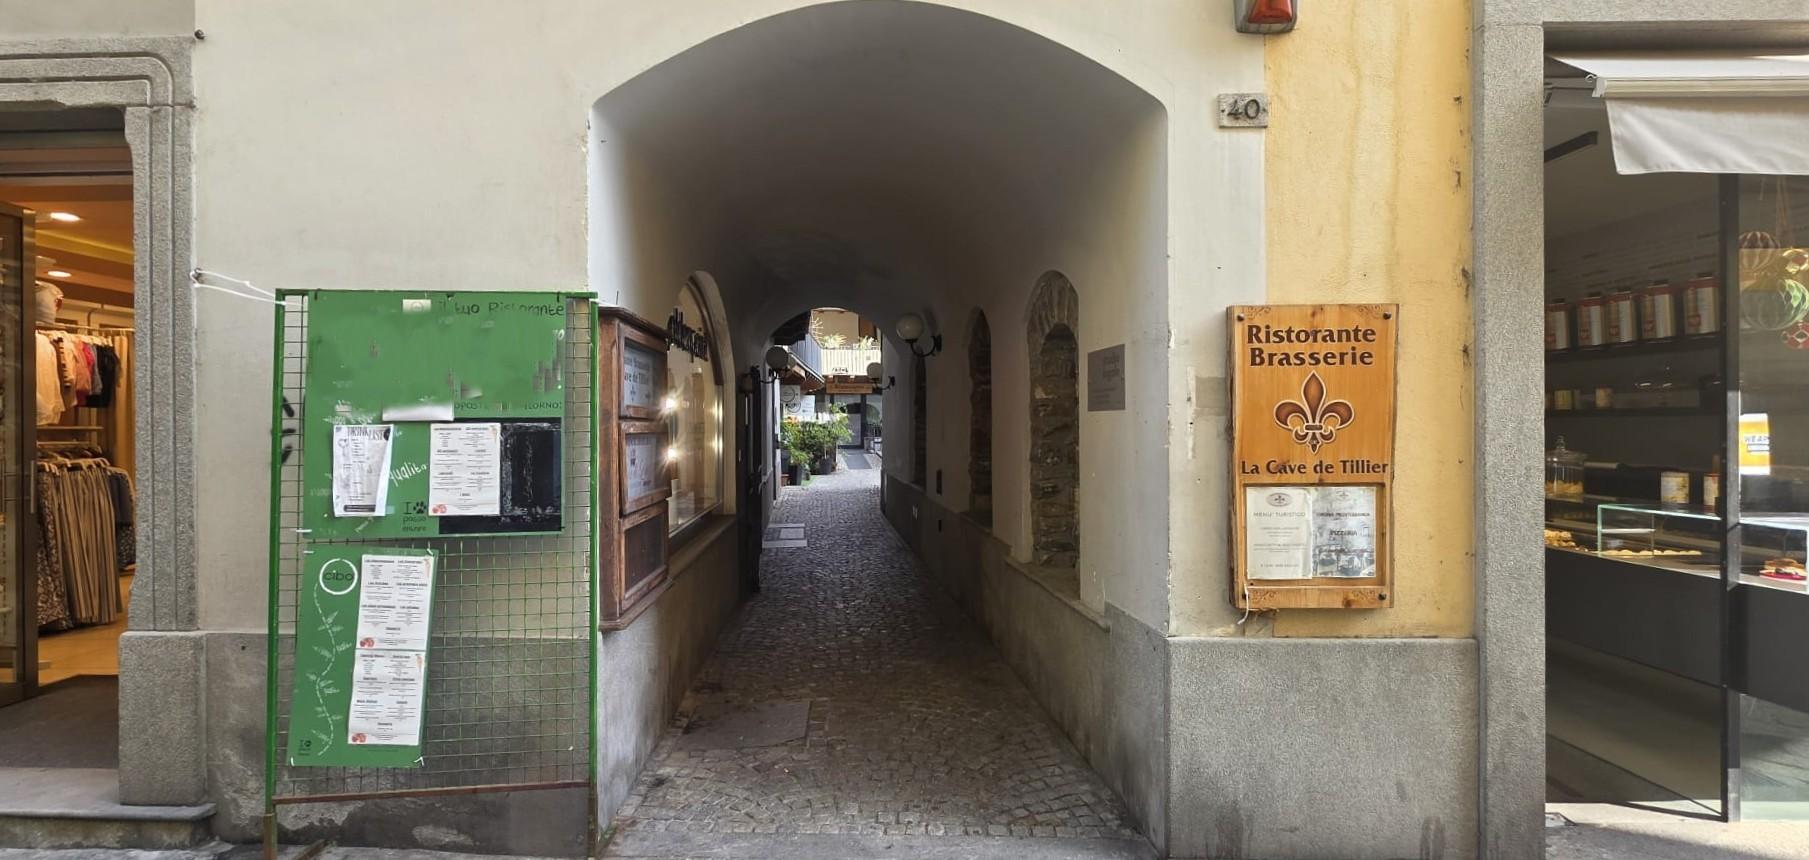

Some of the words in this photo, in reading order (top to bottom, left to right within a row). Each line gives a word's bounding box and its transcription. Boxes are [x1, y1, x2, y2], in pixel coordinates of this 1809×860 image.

[1227, 98, 1260, 120] 40
[1247, 324, 1377, 344] Ristorante
[1250, 346, 1374, 366] Brasserie
[1241, 460, 1260, 474] La
[1266, 460, 1307, 474] Cave
[1313, 460, 1335, 474] de
[1340, 459, 1388, 474] Tillier
[324, 569, 354, 581] cibo
